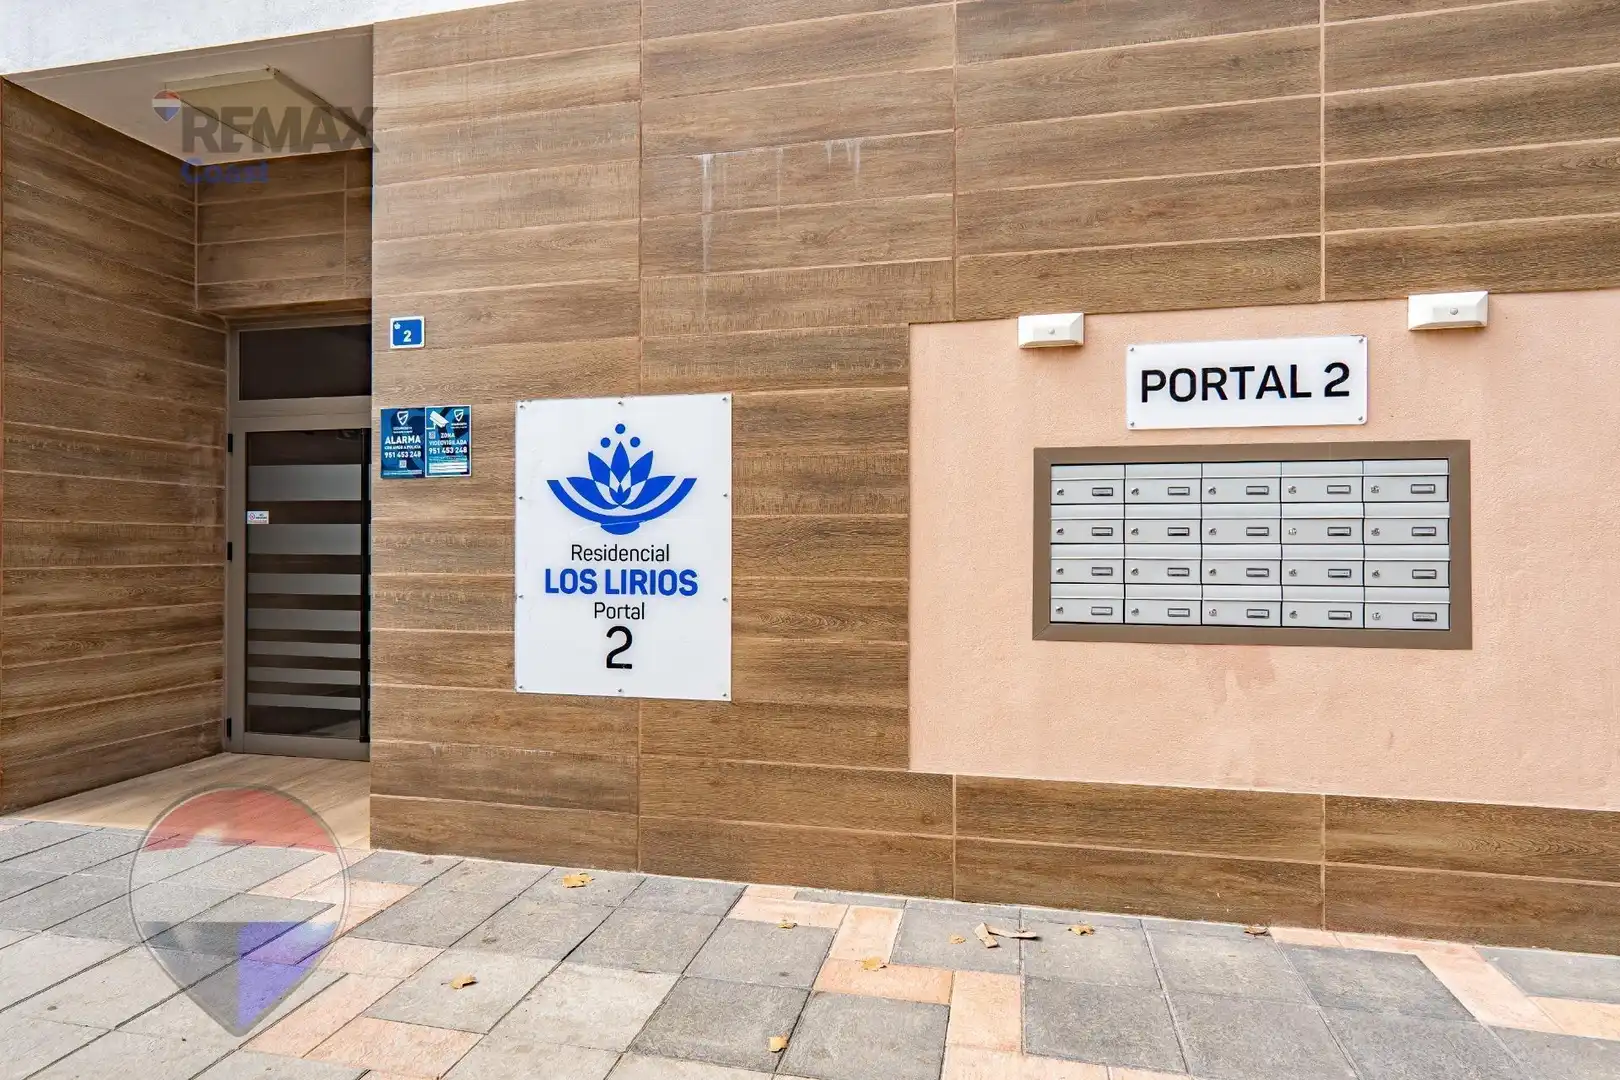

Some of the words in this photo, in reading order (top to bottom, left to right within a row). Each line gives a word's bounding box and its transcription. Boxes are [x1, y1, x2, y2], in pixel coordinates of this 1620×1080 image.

[403, 329, 412, 343] 2
[1141, 363, 1312, 403] PORTAL
[1323, 362, 1350, 398] 2
[384, 435, 422, 445] ALARMA
[384, 451, 396, 459] 951
[428, 447, 440, 455] 951
[441, 446, 454, 454] 453
[454, 445, 468, 454] 248
[571, 543, 670, 562] Residencial
[545, 568, 598, 595] LOS
[604, 568, 699, 597] LIRIOS
[594, 601, 645, 621] Portal
[605, 625, 633, 670] 2
